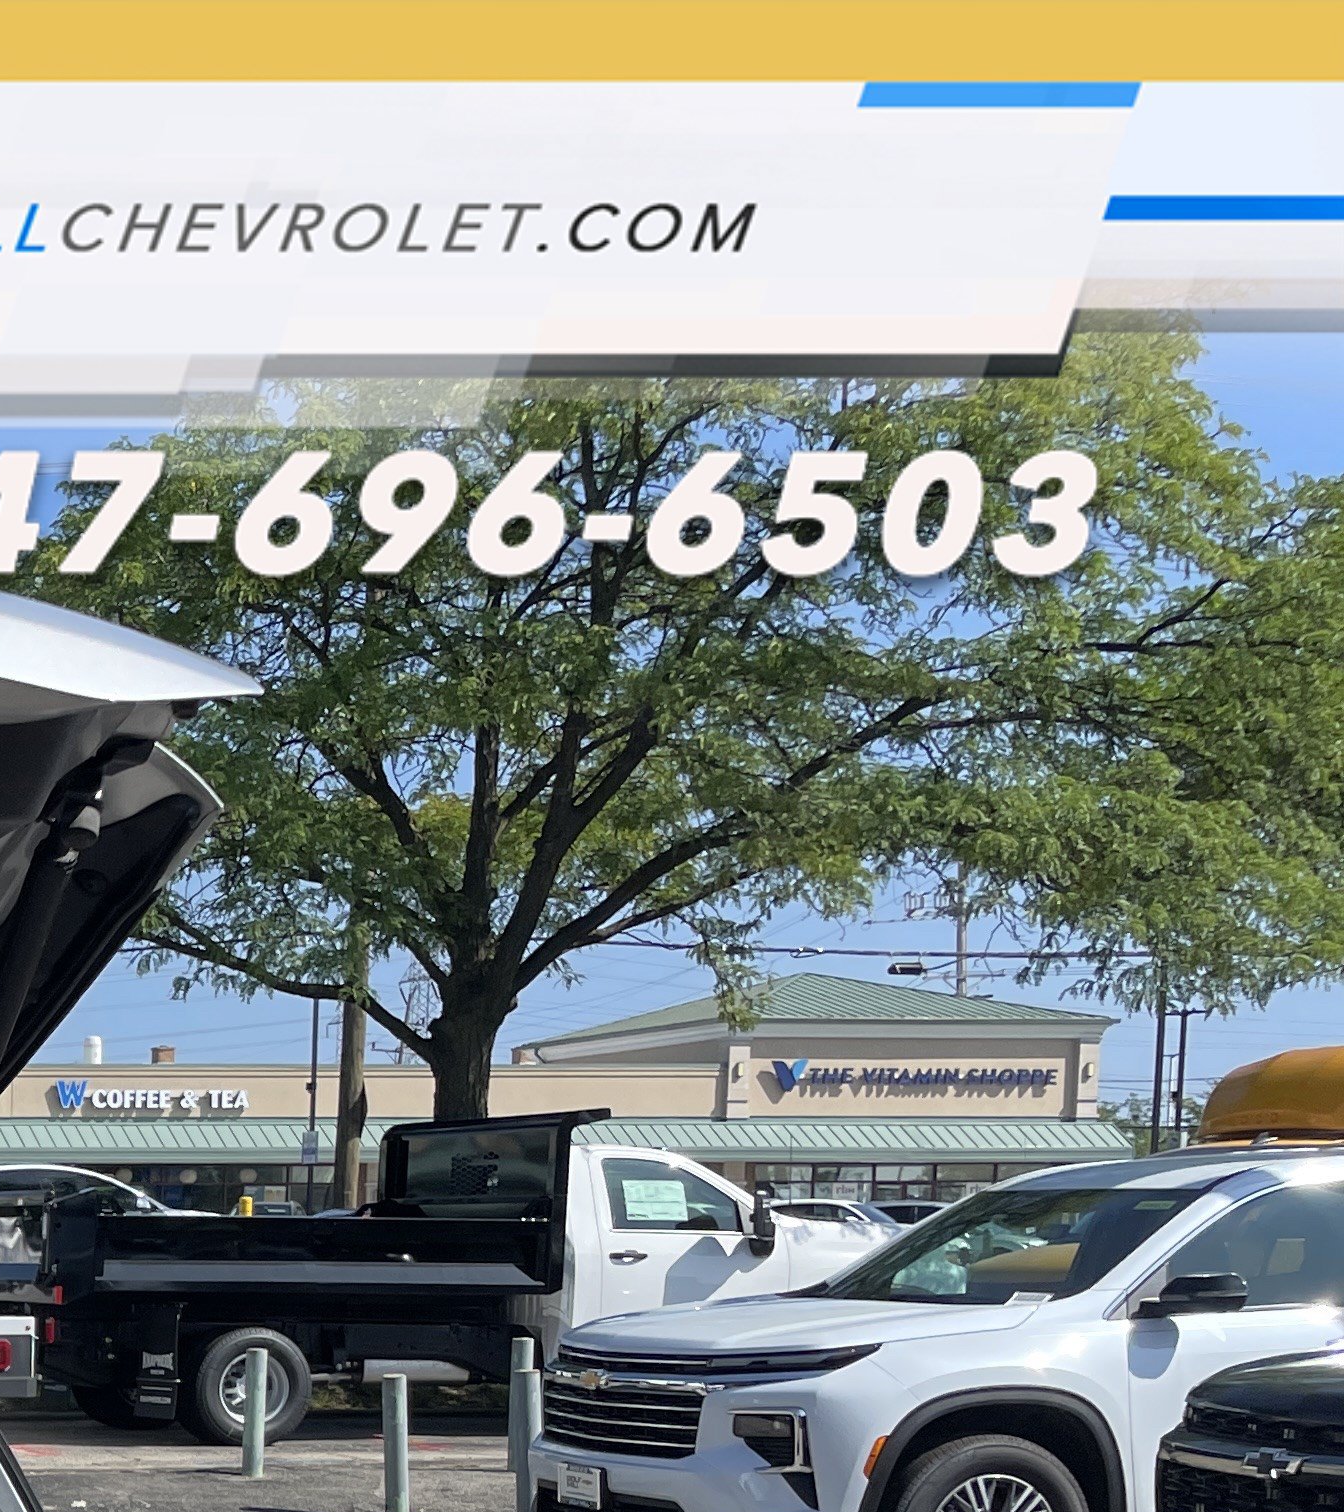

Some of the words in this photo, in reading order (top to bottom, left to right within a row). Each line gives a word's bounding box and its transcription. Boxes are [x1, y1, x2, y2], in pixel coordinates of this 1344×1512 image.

[809, 1067, 854, 1084] THE
[862, 1067, 962, 1086] VITAMIN
[966, 1068, 1059, 1086] SHOPPE
[56, 1079, 88, 1109] W
[91, 1088, 173, 1109] COFFEE
[180, 1089, 199, 1109] &
[208, 1088, 250, 1109] TEA
